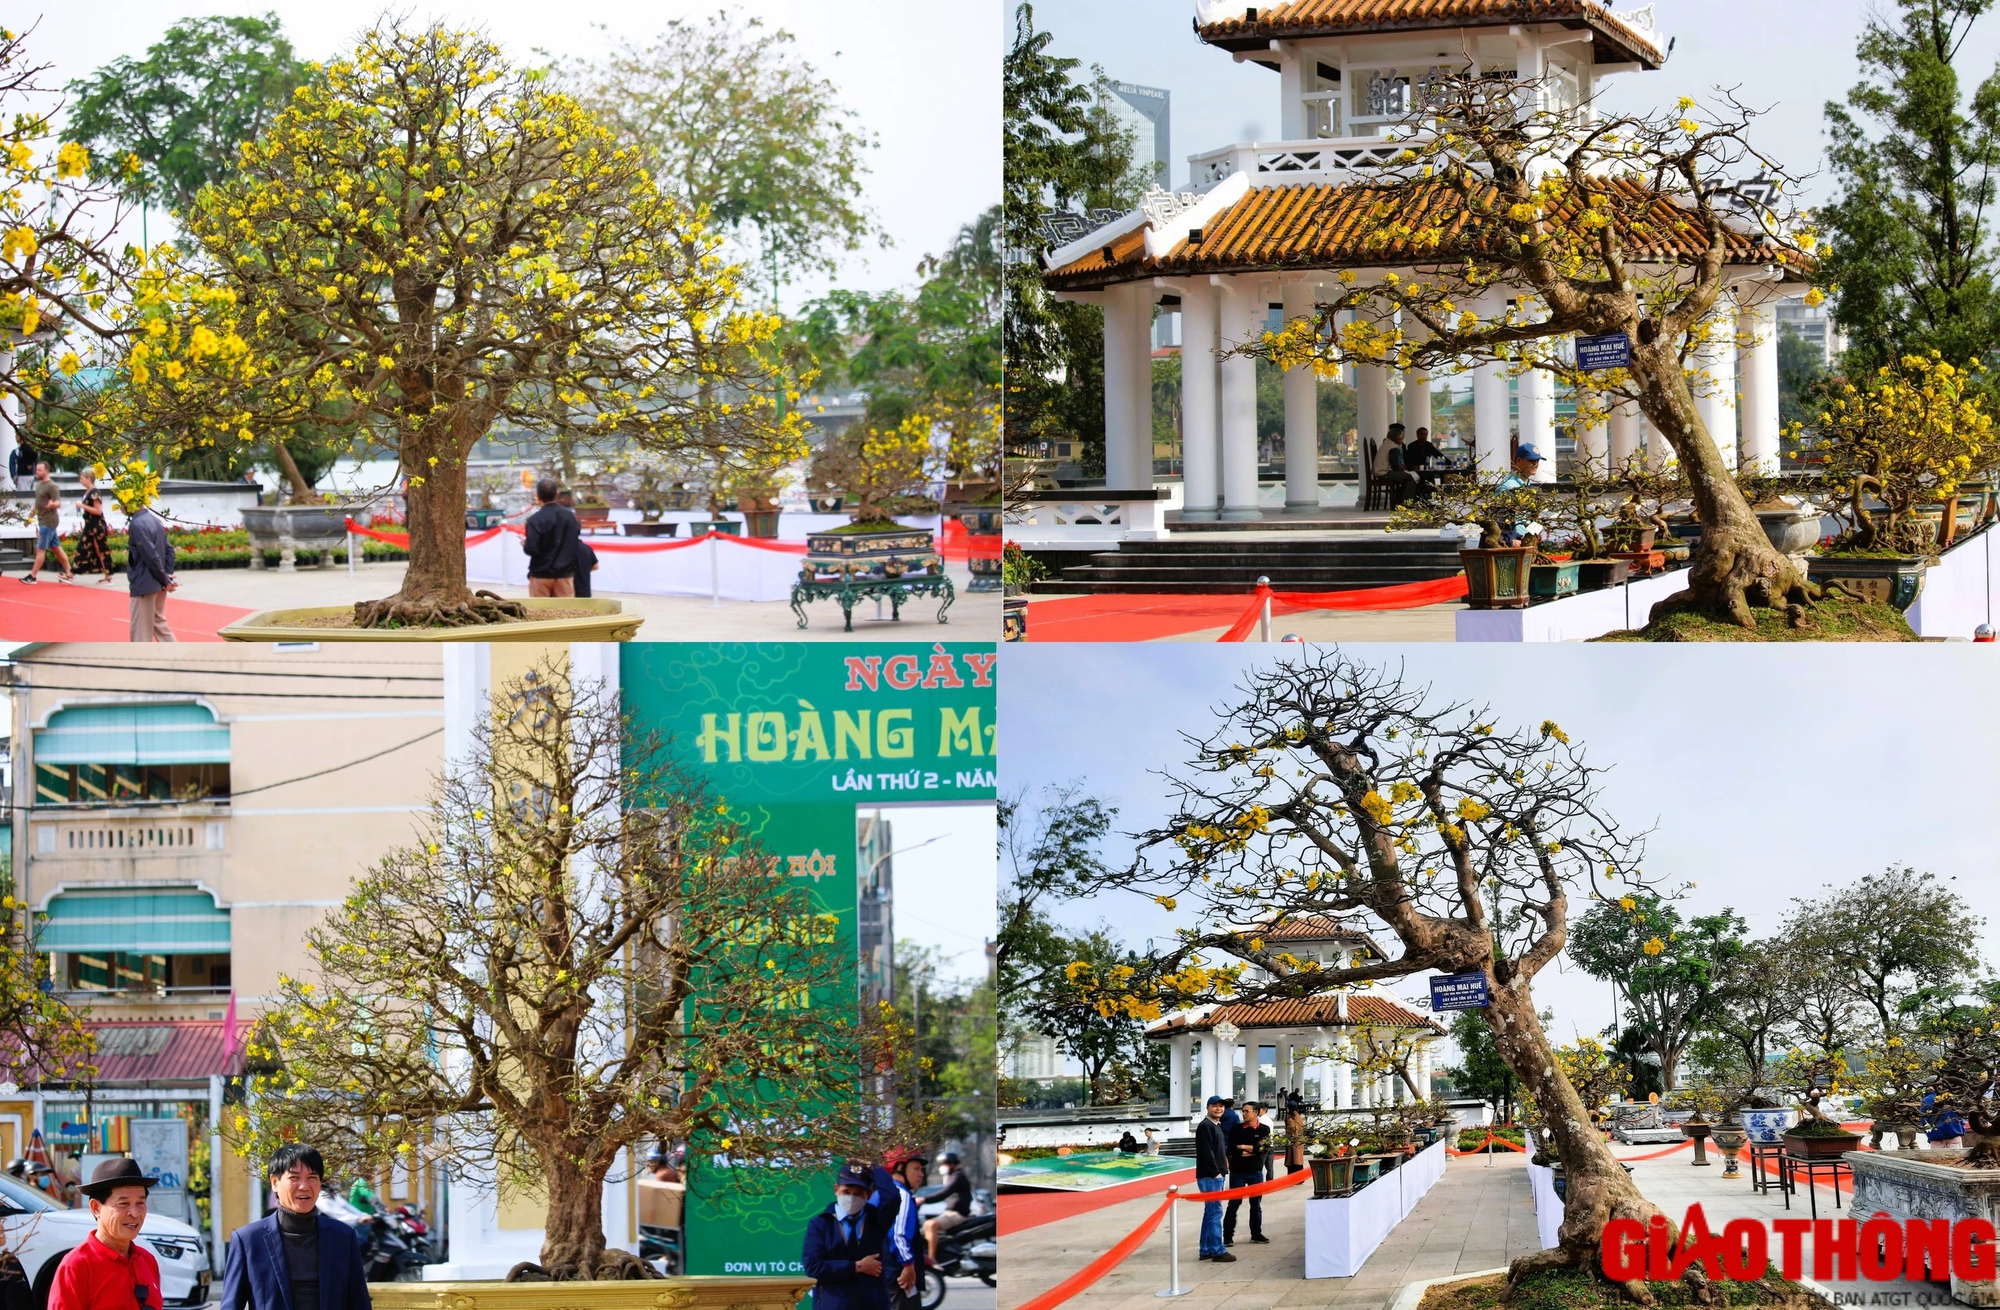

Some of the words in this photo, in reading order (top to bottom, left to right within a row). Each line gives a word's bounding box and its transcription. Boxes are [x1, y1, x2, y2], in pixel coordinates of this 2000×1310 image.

[1138, 88, 1164, 99] VINPEARL
[1579, 344, 1600, 354] HOÀNG
[1613, 340, 1626, 350] HUẾ
[844, 644, 996, 690] NGÀY
[696, 699, 914, 763] HOÀNG
[832, 768, 872, 791] LẦN
[877, 769, 920, 790] THỨ
[924, 773, 938, 788] 2
[788, 848, 836, 883] HỘI
[1434, 984, 1456, 993] HOÀNG
[1456, 983, 1469, 991] MAI
[1470, 980, 1483, 990] HUẾ
[724, 1262, 752, 1272] ĐƠN
[754, 1262, 767, 1274] VỊ
